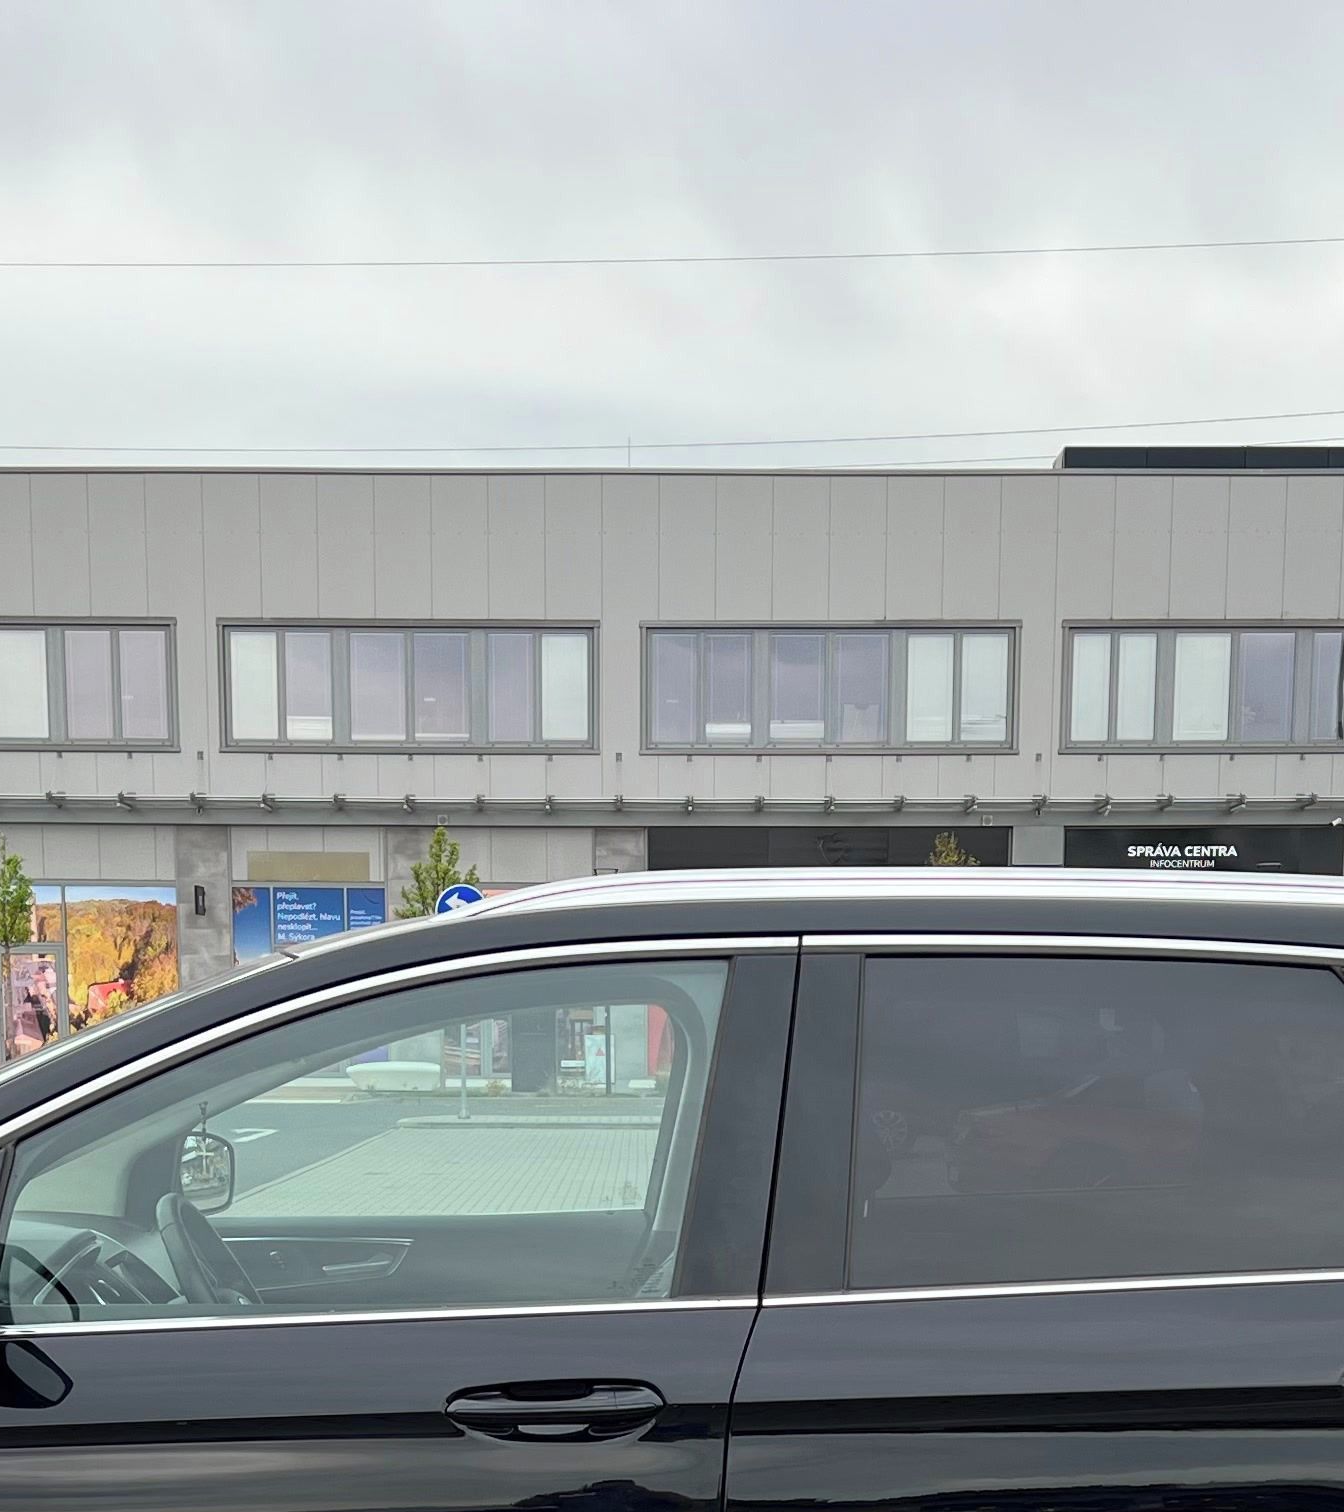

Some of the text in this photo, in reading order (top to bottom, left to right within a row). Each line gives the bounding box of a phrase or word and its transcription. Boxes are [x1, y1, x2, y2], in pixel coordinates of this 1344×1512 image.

[1127, 843, 1238, 857] SPRÁVA CENTRA
[1149, 859, 1215, 868] INFOCENTRUM
[319, 912, 341, 921] hlavu
